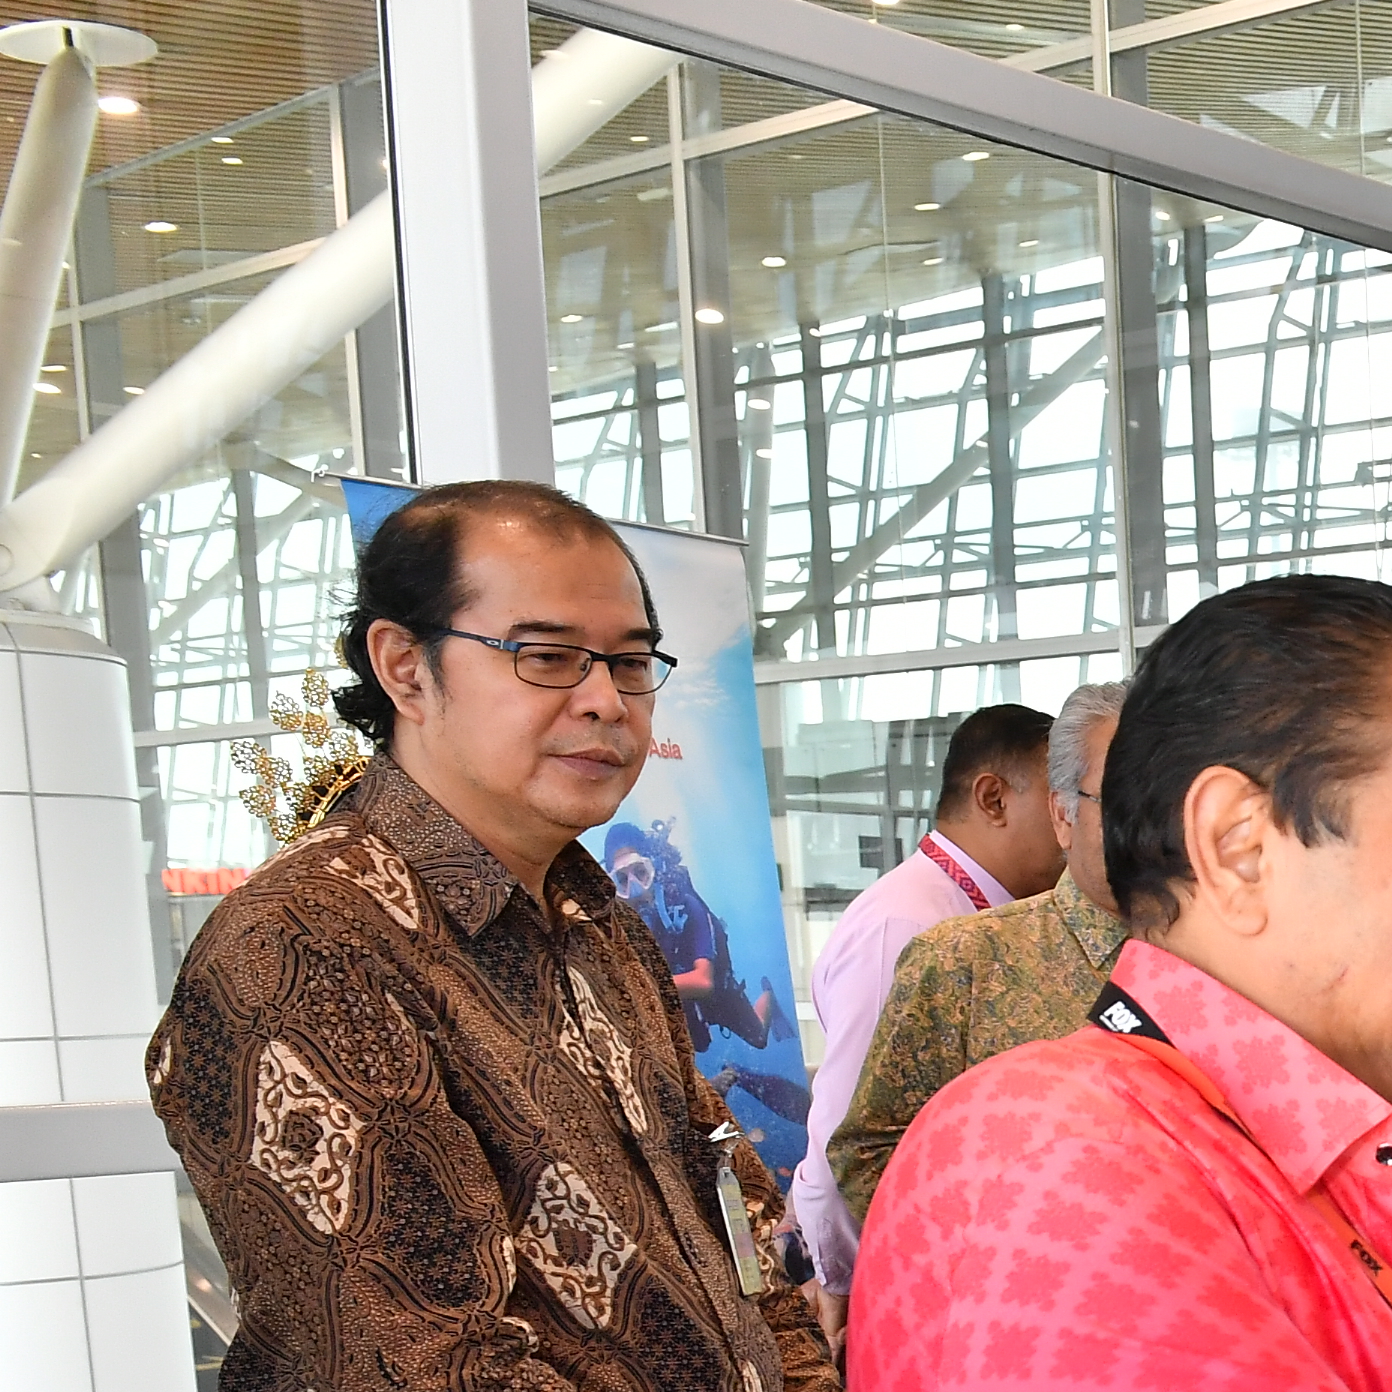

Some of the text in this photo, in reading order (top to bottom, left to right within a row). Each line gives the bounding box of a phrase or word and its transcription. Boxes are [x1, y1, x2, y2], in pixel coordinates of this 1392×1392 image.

[648, 737, 683, 760] Asia
[1103, 1000, 1143, 1033] FOX
[1350, 1239, 1382, 1277] FOX
